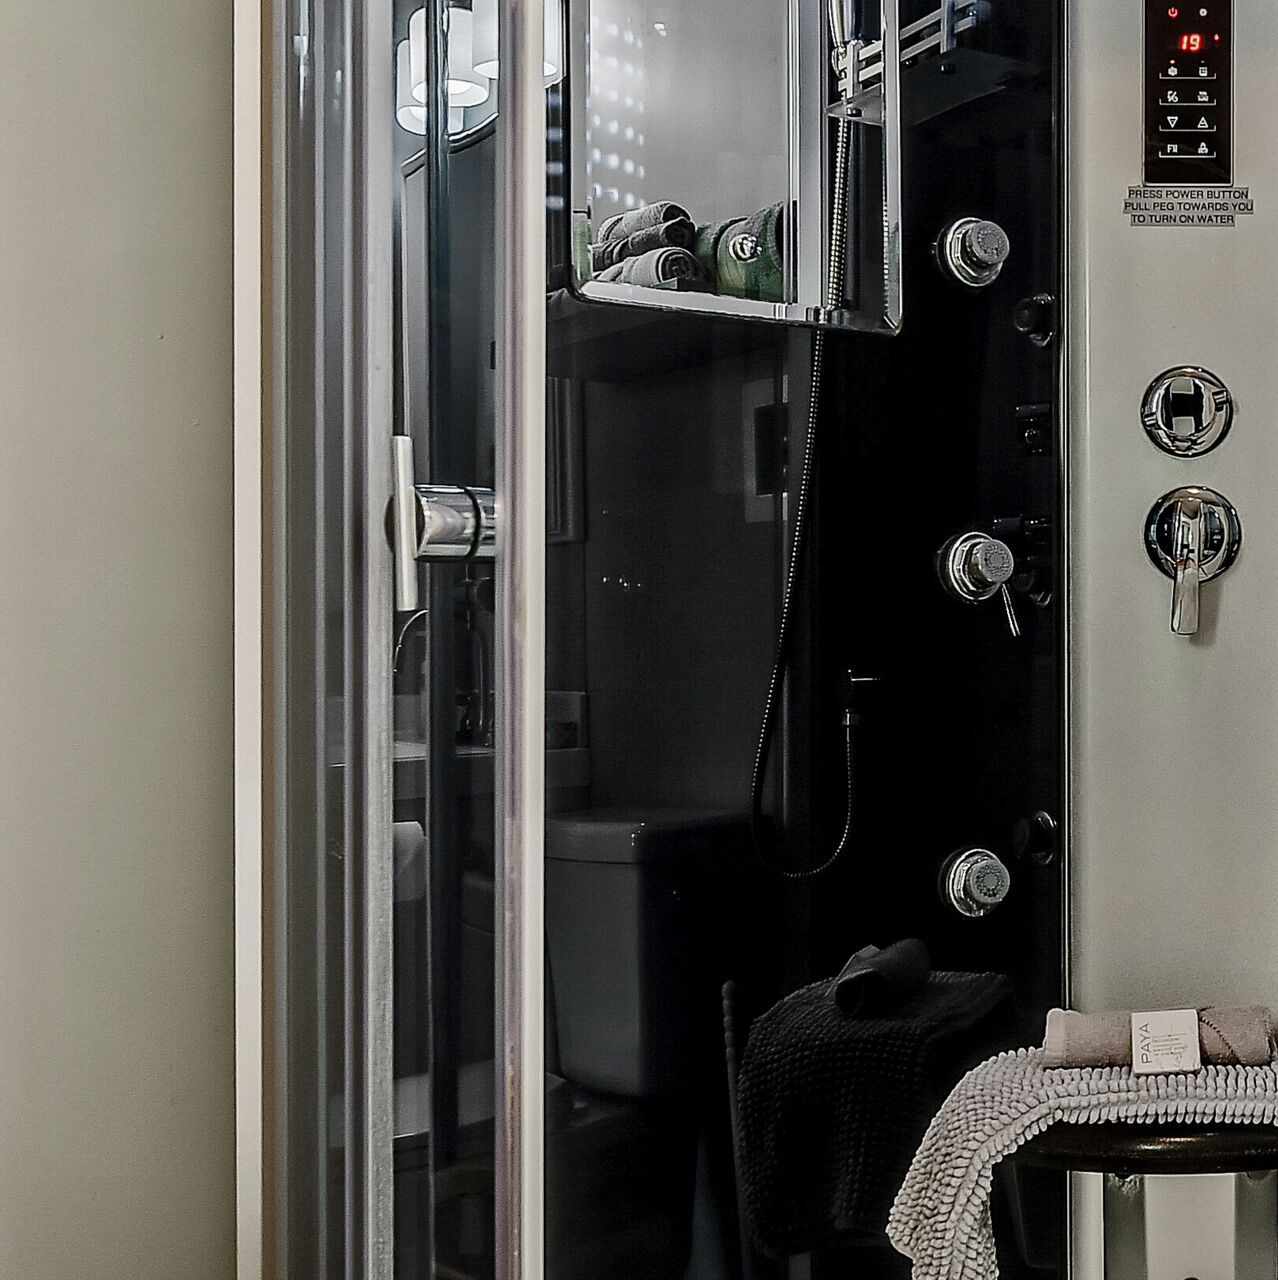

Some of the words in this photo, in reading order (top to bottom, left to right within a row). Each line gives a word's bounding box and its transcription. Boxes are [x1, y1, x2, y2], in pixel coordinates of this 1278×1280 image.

[1181, 34, 1201, 51] 19
[1128, 190, 1163, 199] PRESS
[1165, 190, 1204, 199] POWER
[1207, 190, 1249, 199] BUTTON
[1124, 202, 1150, 211] PULL
[1153, 202, 1175, 211] PEG
[1177, 202, 1229, 211] TOWARDS
[1231, 202, 1254, 211] YOU
[1132, 214, 1146, 223] TO
[1148, 214, 1177, 223] TURN
[1179, 214, 1195, 223] ON
[1197, 214, 1234, 223] WATER
[1139, 1022, 1152, 1064] PAYA
